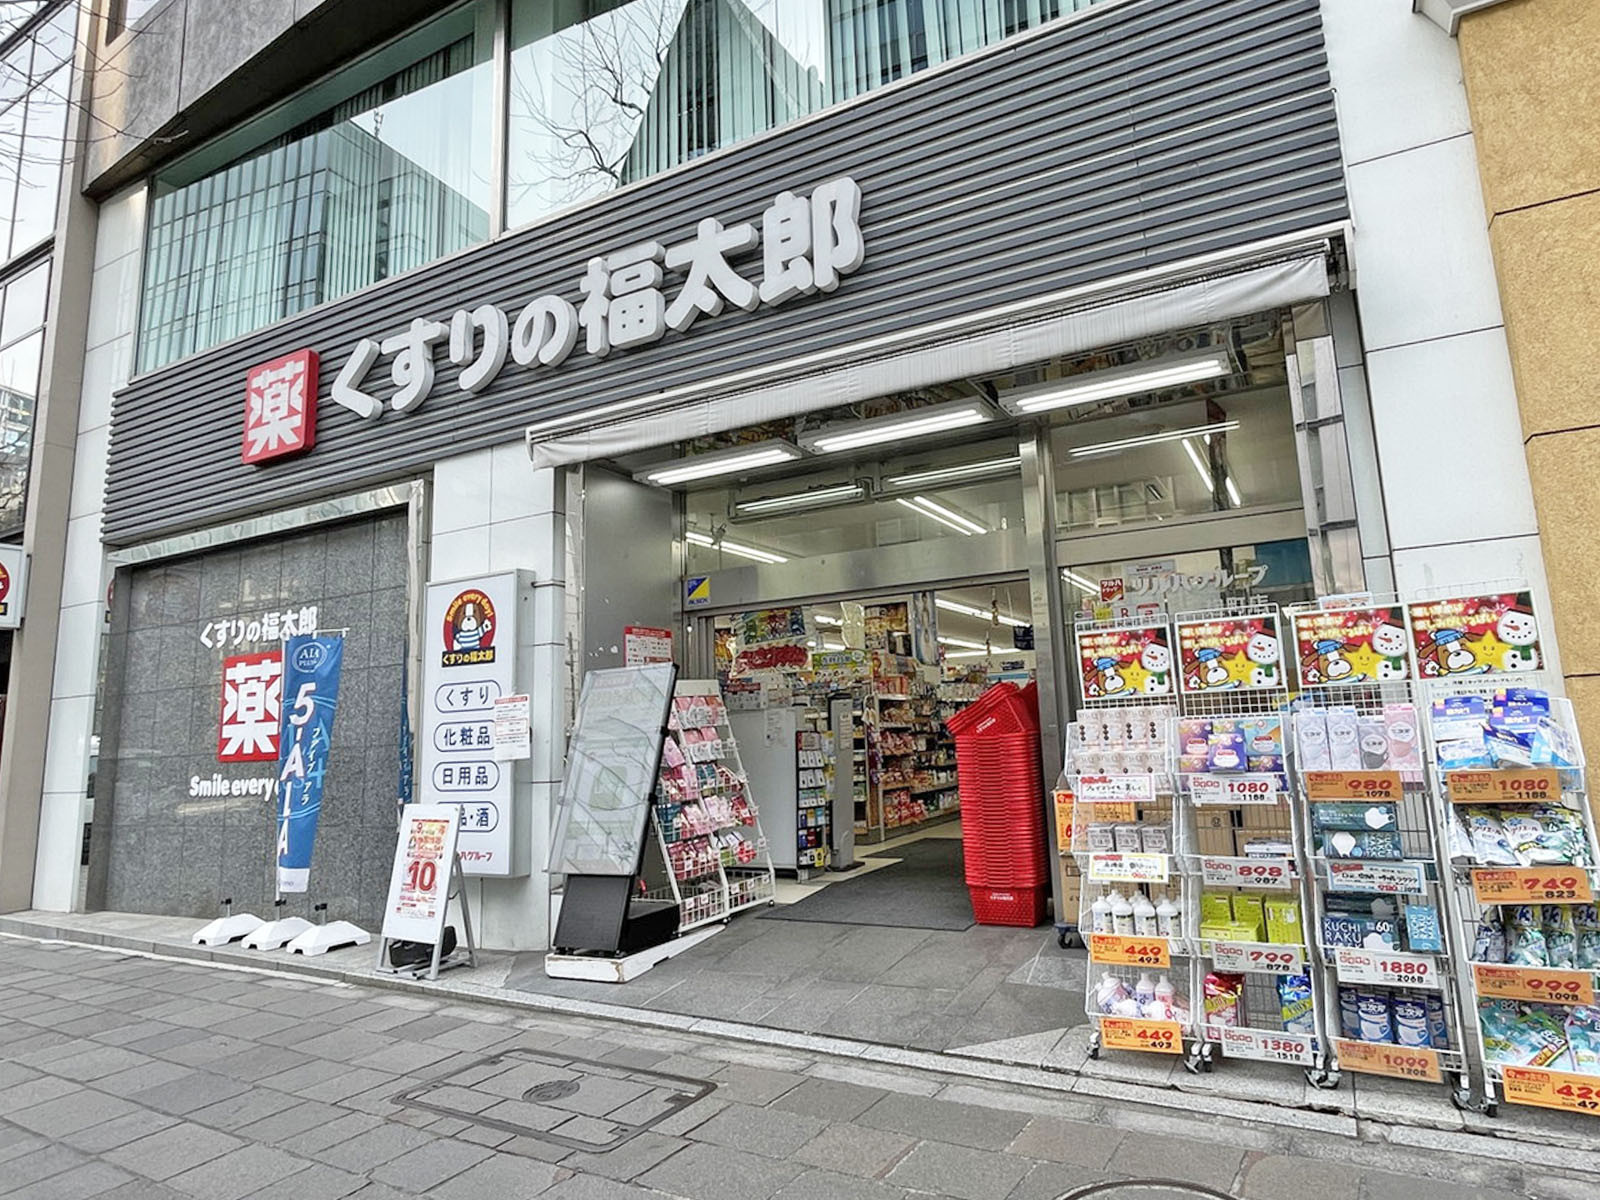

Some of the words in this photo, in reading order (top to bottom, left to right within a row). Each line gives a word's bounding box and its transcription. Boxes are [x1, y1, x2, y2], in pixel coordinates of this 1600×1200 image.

[247, 354, 306, 456] 薬
[331, 176, 865, 421] くすりの福太郎
[199, 605, 318, 648] くすりの福太郎
[446, 686, 489, 707] くすり
[221, 659, 281, 756] 薬
[444, 726, 490, 747] 化粧品
[442, 766, 488, 785] 日用品
[189, 774, 230, 798] Smile
[231, 778, 275, 802] every
[1227, 782, 1269, 793] 1080
[1348, 780, 1393, 790] 980
[1500, 779, 1549, 791] 1080
[408, 861, 437, 892] 10
[1239, 866, 1283, 877] 898
[1523, 877, 1577, 890] 749
[1545, 890, 1576, 899] 823
[1323, 920, 1361, 933] KUCHI
[1324, 930, 1362, 943] RAKU
[1125, 945, 1162, 956] 449
[1249, 951, 1294, 963] 799
[1138, 956, 1160, 964] 493
[1380, 961, 1429, 975] 1880
[1526, 979, 1581, 992] 999
[1137, 1029, 1174, 1041] 449
[1150, 1041, 1172, 1049] 493
[1261, 1039, 1305, 1053] 1380
[1383, 1054, 1429, 1069] 1099
